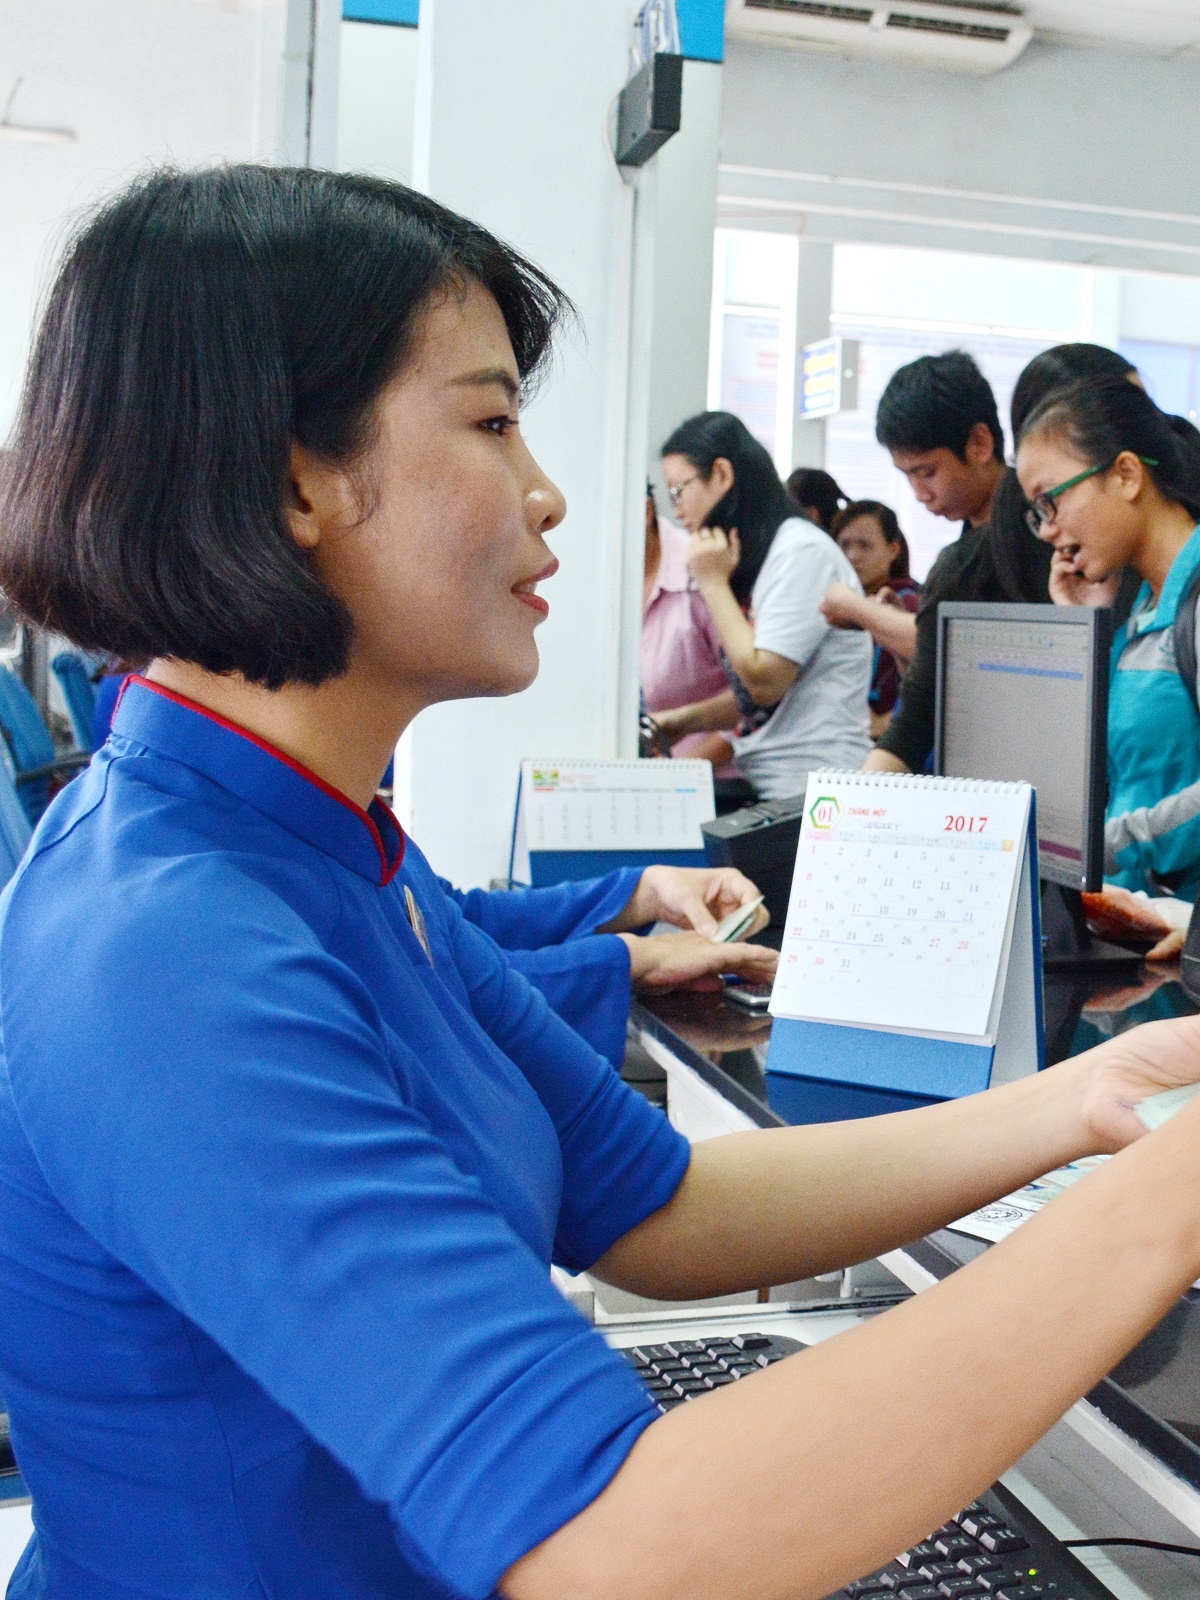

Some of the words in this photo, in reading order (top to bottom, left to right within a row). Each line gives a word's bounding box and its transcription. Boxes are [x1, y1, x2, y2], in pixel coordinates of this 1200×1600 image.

[818, 806, 833, 823] 01
[862, 820, 901, 832] JANUARY
[943, 815, 989, 834] 2017
[837, 846, 844, 856] 2
[865, 848, 871, 858] 3
[892, 850, 899, 859] 4
[920, 851, 927, 861] 5
[949, 853, 955, 863] 6
[979, 855, 985, 865] 7
[806, 872, 813, 881] 8
[833, 874, 840, 883] 9
[856, 875, 867, 885] 10
[883, 877, 893, 887] 11
[912, 879, 922, 889] 12
[940, 881, 950, 891] 13
[969, 883, 979, 893] 14
[798, 899, 808, 909] 15
[825, 901, 835, 911] 16
[852, 903, 862, 913] 17
[879, 905, 889, 915] 18
[907, 907, 917, 917] 19
[934, 910, 946, 919] 20
[963, 912, 974, 922] 21
[792, 927, 804, 936] 22
[819, 928, 830, 938] 23
[846, 931, 857, 941] 24
[873, 933, 884, 943] 25
[901, 935, 912, 946] 26
[929, 937, 940, 948] 27
[957, 940, 969, 950] 28
[787, 953, 798, 964] 29
[813, 956, 825, 966] 30
[840, 958, 851, 969] 31
